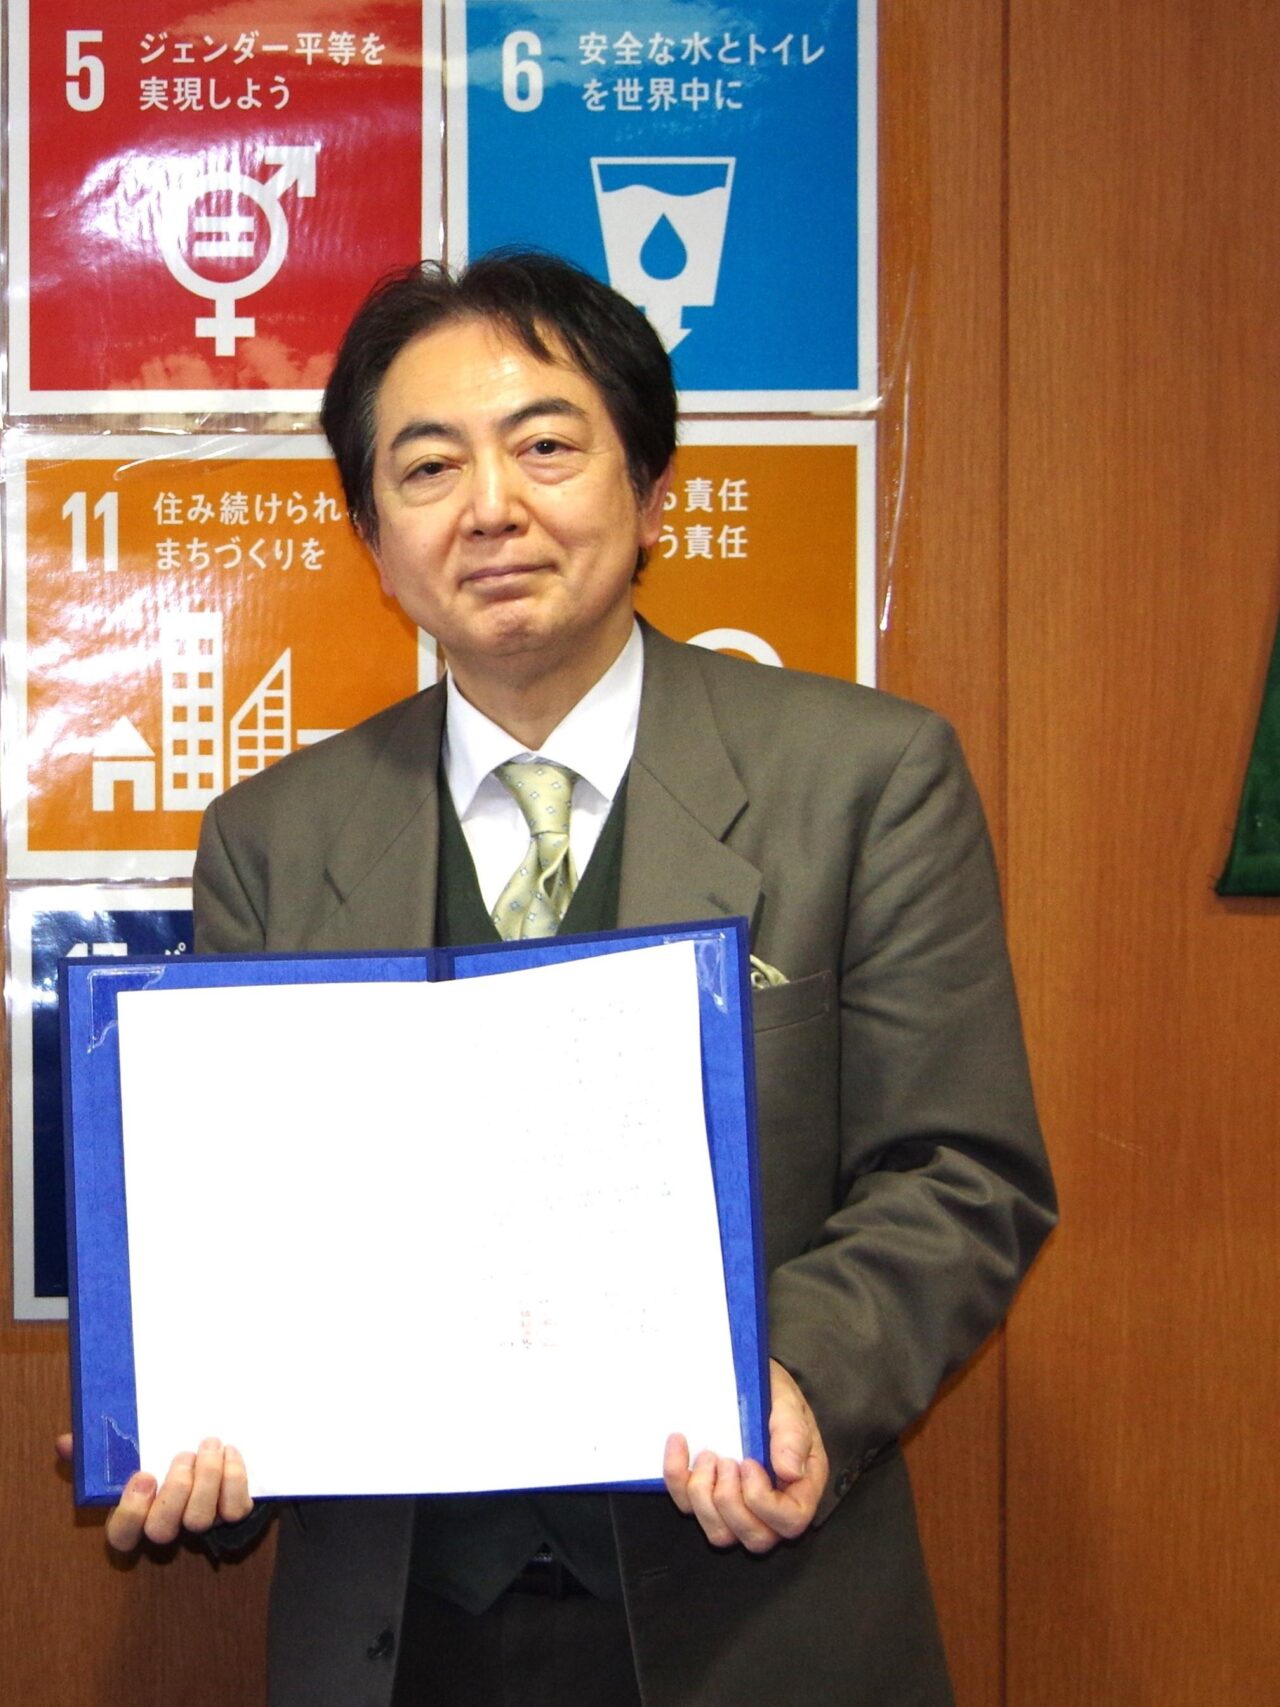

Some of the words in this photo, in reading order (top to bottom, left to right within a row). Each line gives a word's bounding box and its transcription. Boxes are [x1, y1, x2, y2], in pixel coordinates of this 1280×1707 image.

[139, 31, 385, 66] ジェンダー平等を
[578, 31, 825, 66] 安全な水とトイレ
[65, 30, 105, 112] 5
[502, 30, 544, 112] 6
[139, 76, 291, 111] 実現しよう
[582, 77, 743, 112] を世界中に
[153, 491, 349, 525] 住み続けられ
[61, 491, 119, 572] 11
[658, 524, 748, 559] う責任
[156, 537, 326, 571] まちづくりを
